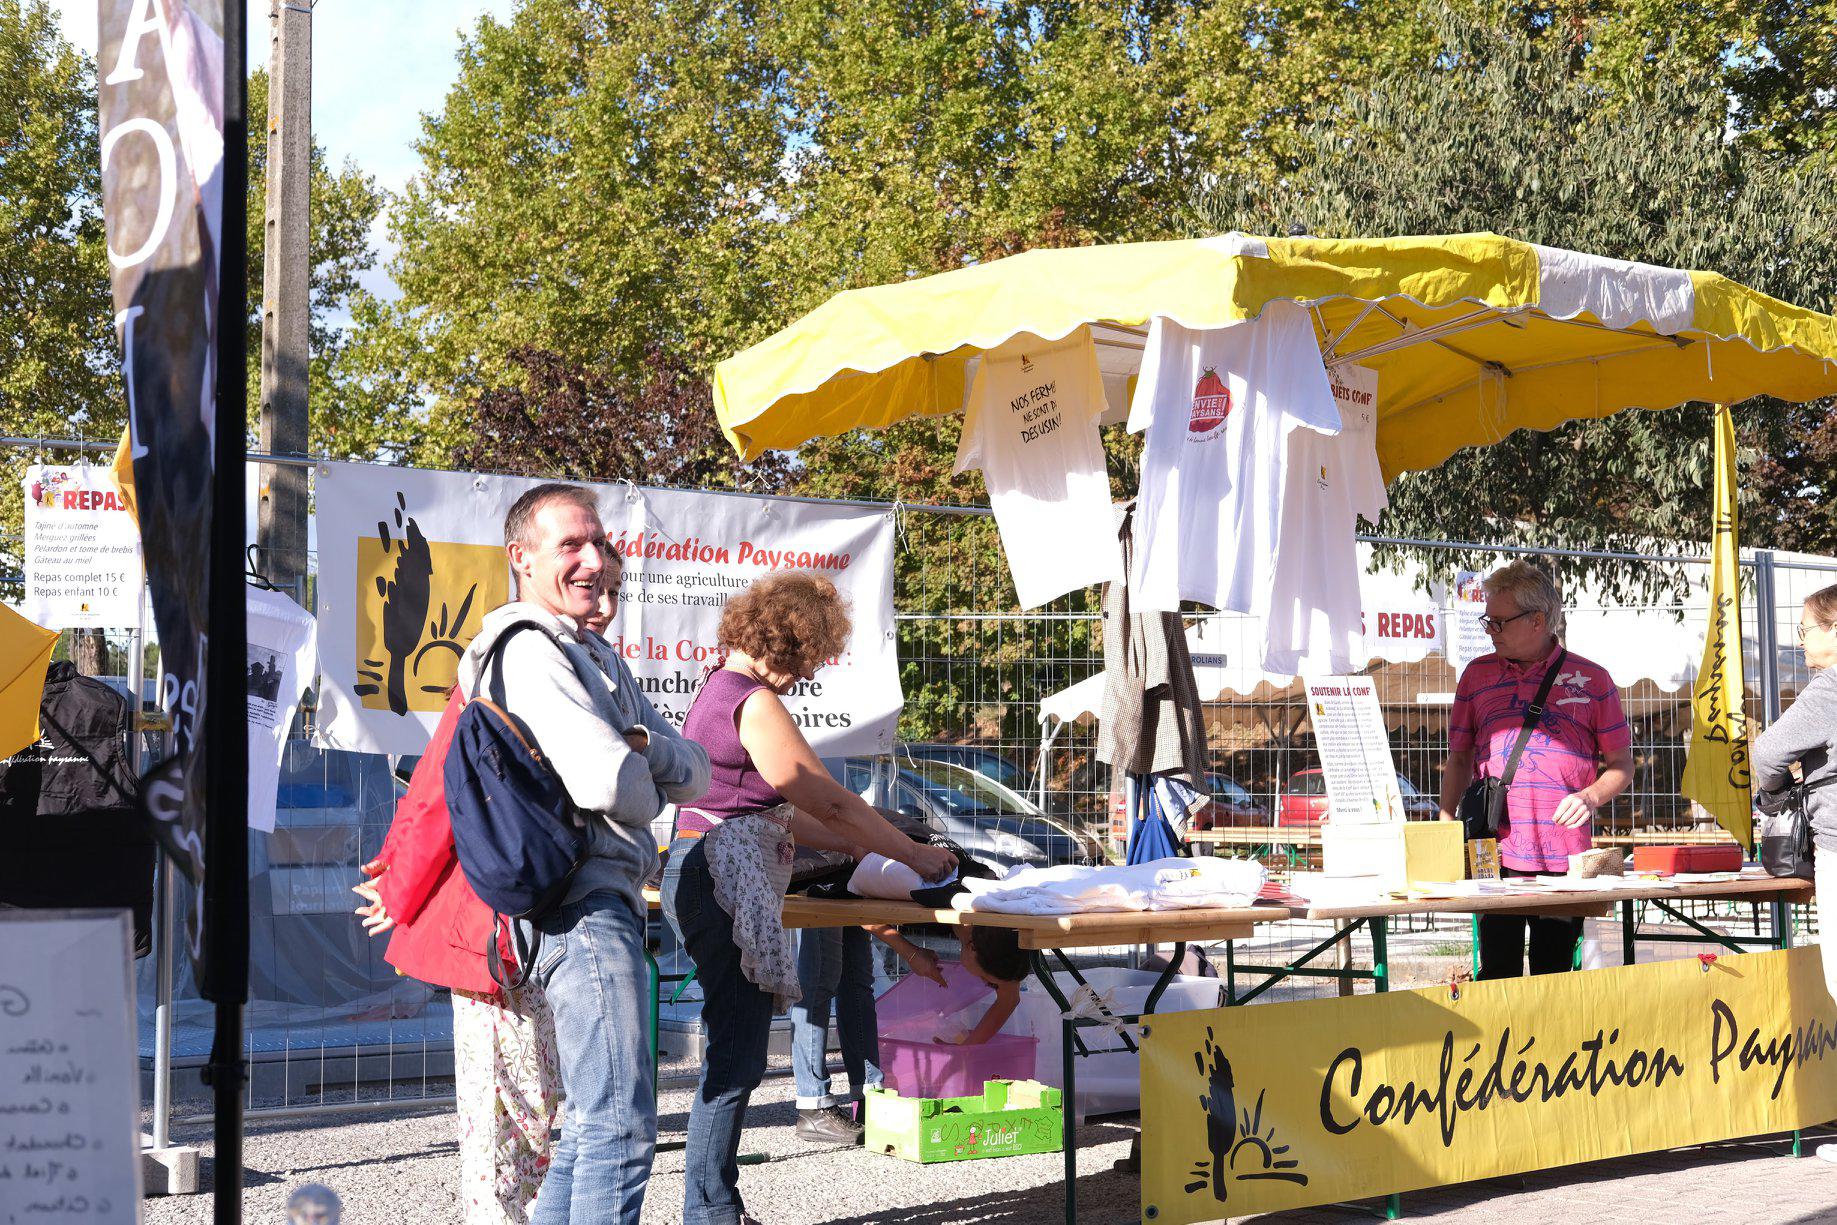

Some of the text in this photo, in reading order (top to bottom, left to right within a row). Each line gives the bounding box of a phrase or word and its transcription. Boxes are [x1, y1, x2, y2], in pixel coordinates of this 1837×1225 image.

[1330, 384, 1351, 401] BJETS
[1011, 393, 1030, 413] NOS
[1038, 412, 1062, 434] USIN!
[100, 545, 110, 553] de
[111, 545, 133, 554] brebis
[606, 531, 851, 571] édération Paysanne
[34, 572, 126, 584] Repas complet 15 €
[620, 571, 749, 588] our une agriculture
[34, 587, 119, 598] Repas enfant 10 €
[619, 589, 728, 607] se de ses travaill
[1377, 611, 1437, 640] REPAS
[613, 636, 731, 662] de la Con
[1191, 655, 1223, 666] ROLIANS
[1310, 686, 1342, 697] SOUTENIR
[1343, 687, 1351, 697] LA
[792, 706, 852, 728] oires
[0, 755, 46, 767] nfédération
[1320, 998, 1837, 1148] Confédération Paysan
[983, 1127, 1020, 1146] Juliet
